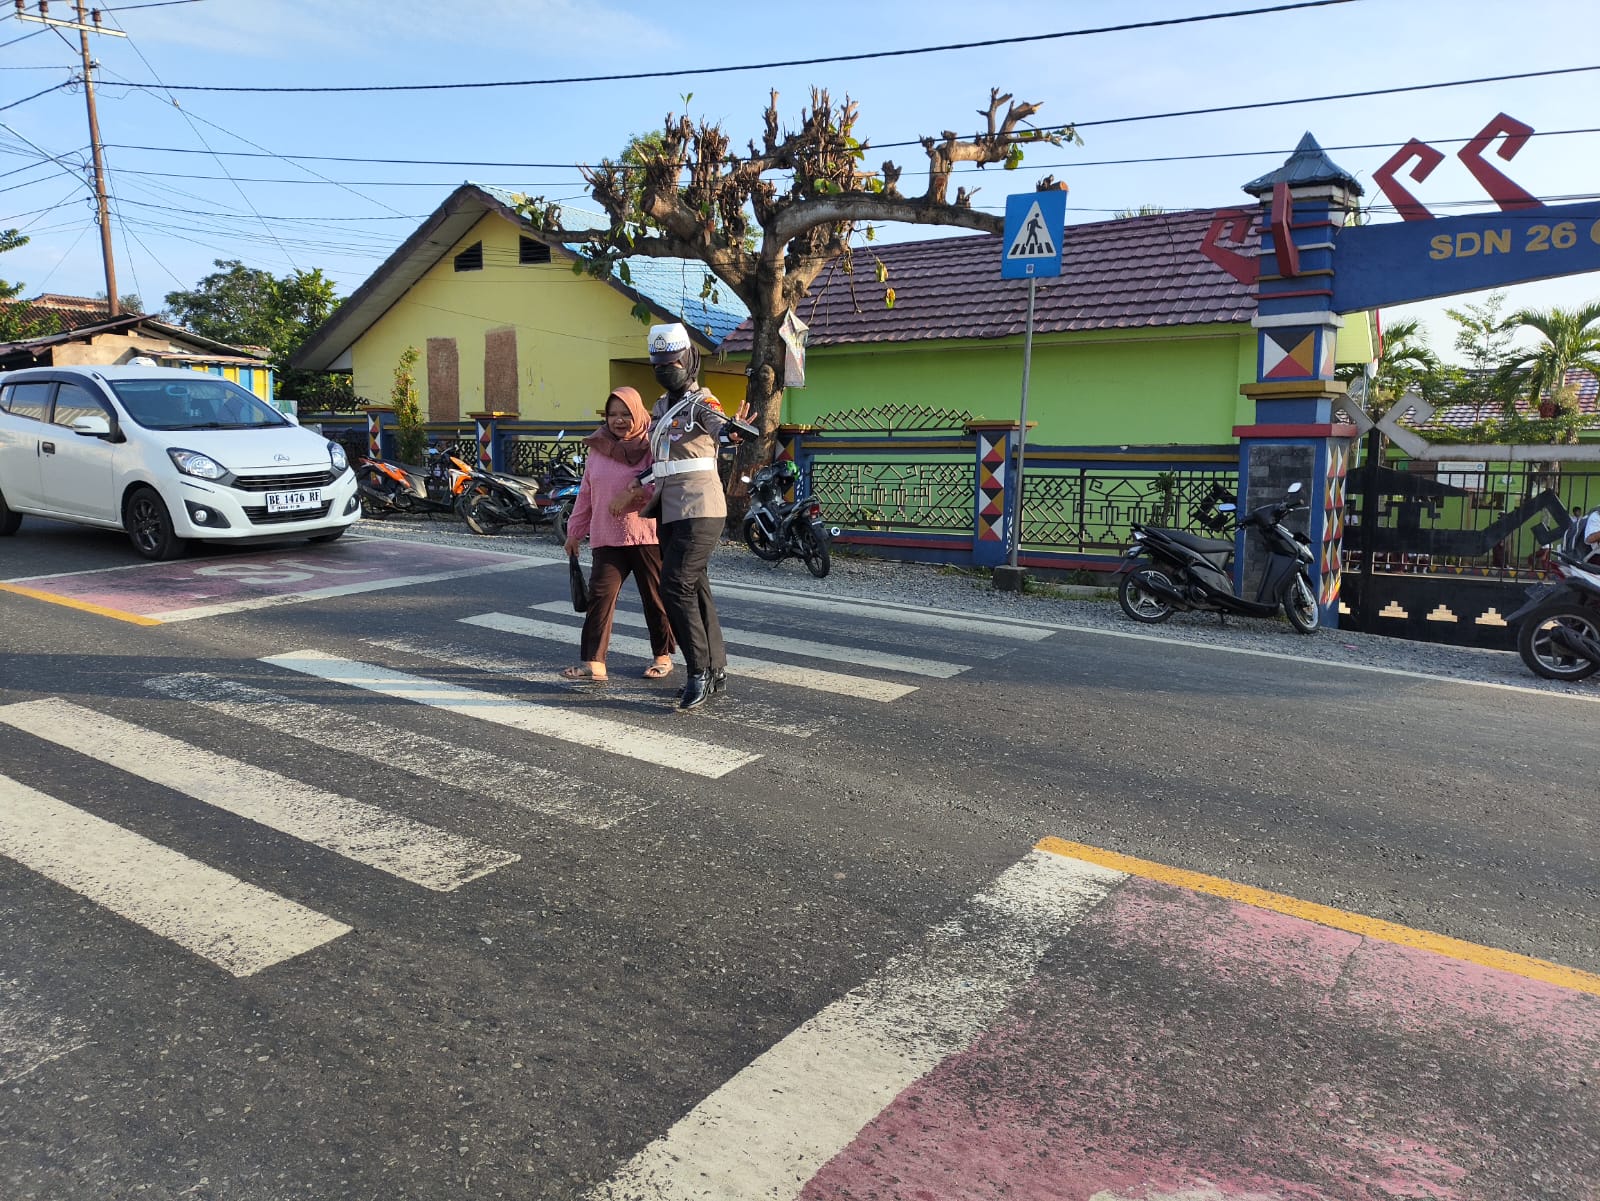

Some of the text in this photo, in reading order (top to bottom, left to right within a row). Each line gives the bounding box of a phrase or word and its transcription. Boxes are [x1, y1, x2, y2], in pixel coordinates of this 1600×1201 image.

[1429, 228, 1511, 260] SDN
[1525, 222, 1577, 252] 26
[269, 495, 280, 505] BE
[285, 493, 305, 504] 1476
